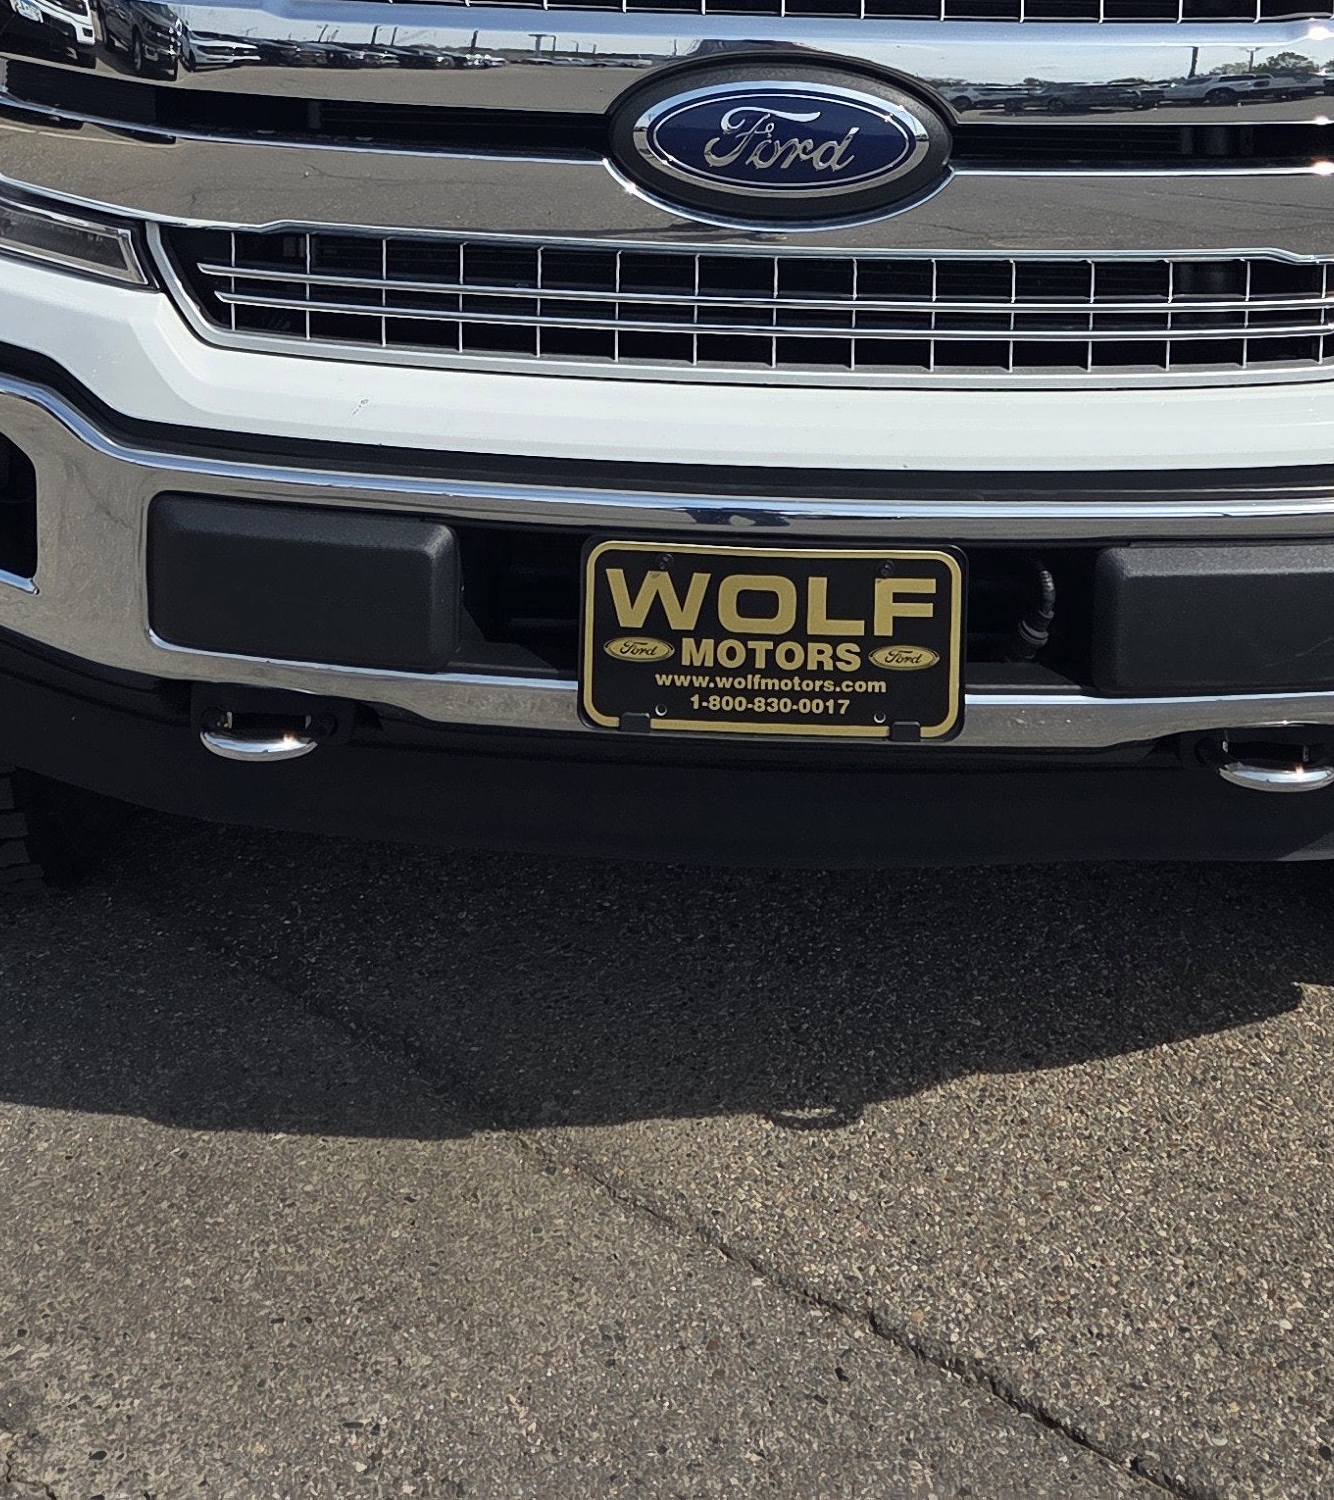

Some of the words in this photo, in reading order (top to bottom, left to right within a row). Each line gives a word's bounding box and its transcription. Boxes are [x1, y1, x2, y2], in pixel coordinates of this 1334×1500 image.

[703, 106, 860, 171] Ford
[605, 568, 937, 637] WOLF
[619, 641, 657, 657] Ford
[681, 637, 862, 672] MOTORS
[884, 650, 922, 664] Ford
[655, 673, 887, 693] www.wolfmotors.com
[690, 694, 851, 715] 1-800-830-0017
